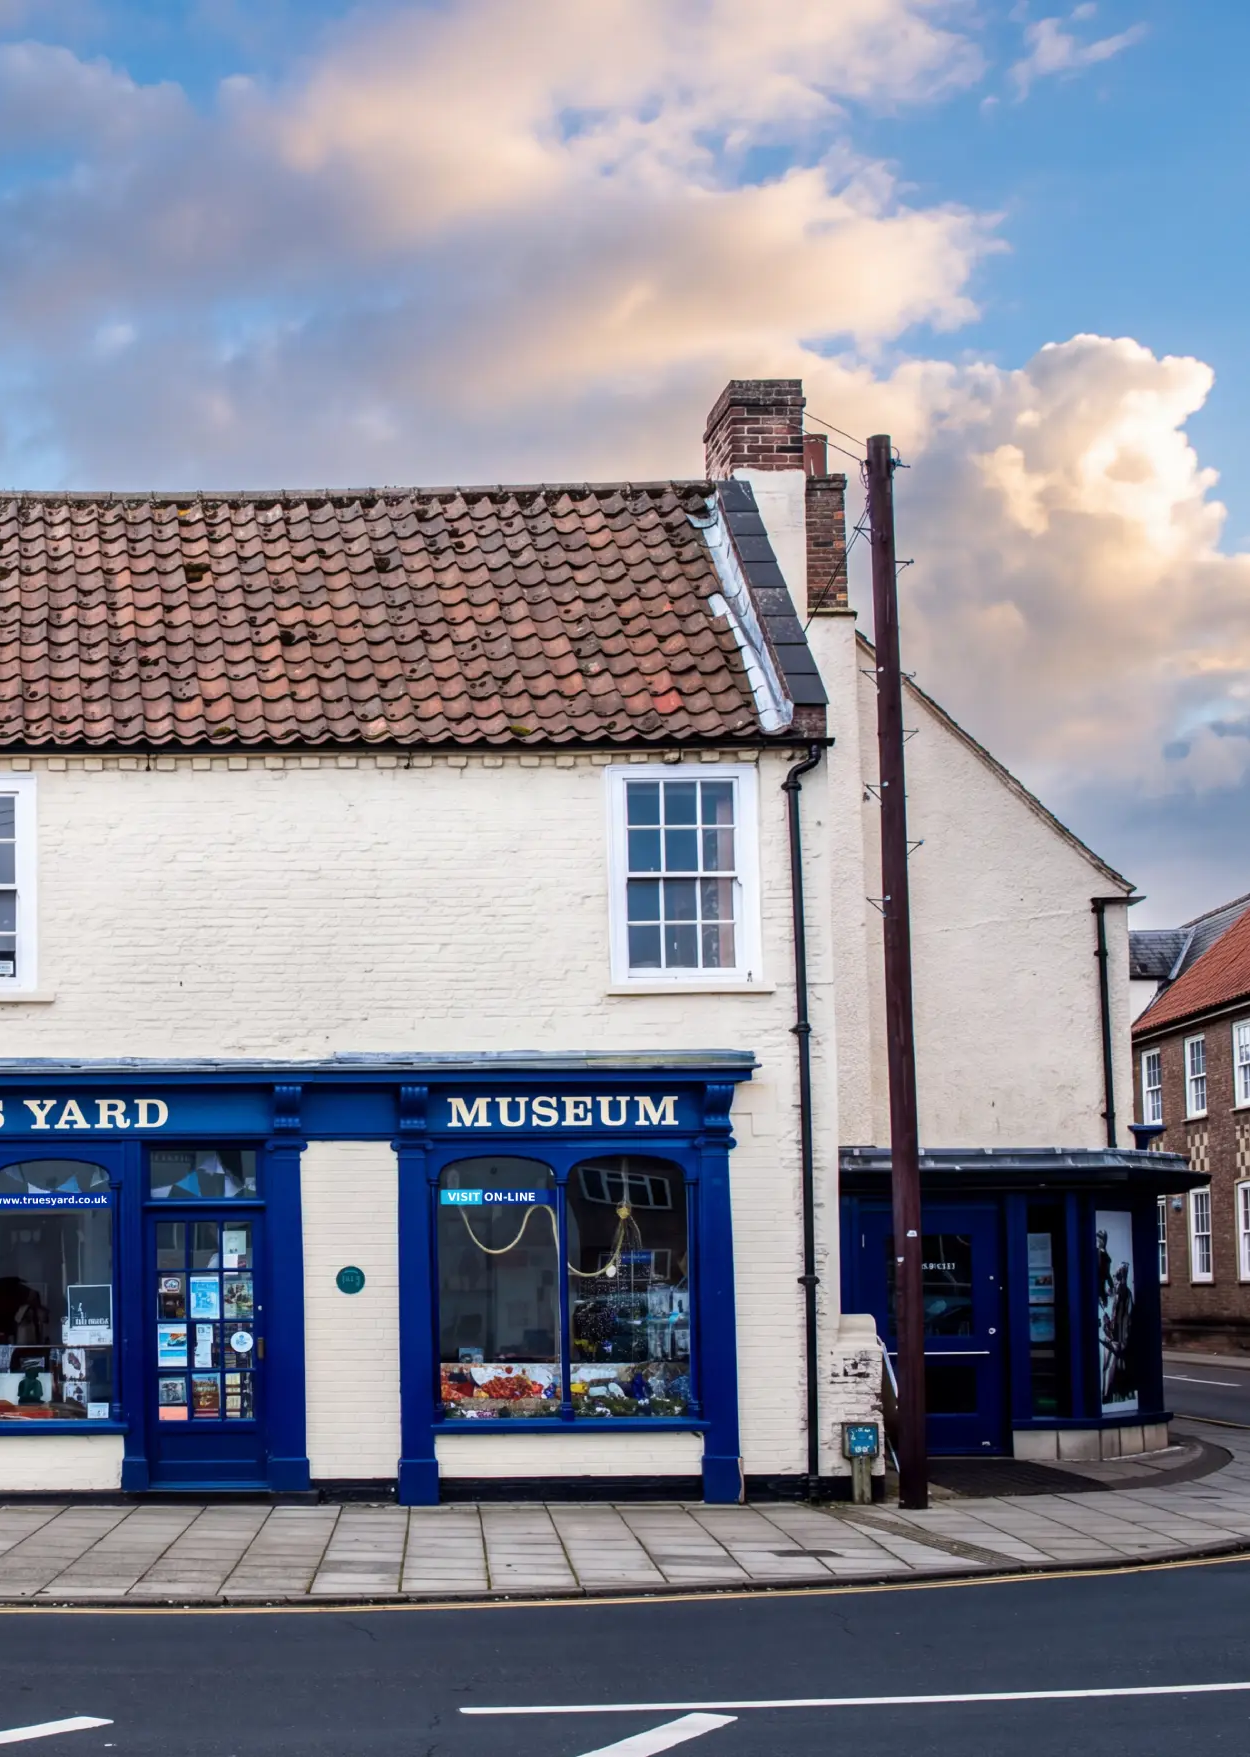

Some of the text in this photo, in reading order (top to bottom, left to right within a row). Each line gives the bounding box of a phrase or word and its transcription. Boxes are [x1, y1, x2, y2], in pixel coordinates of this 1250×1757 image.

[23, 1098, 170, 1130] YARD
[446, 1095, 680, 1127] MUSEUM
[447, 1192, 536, 1202] VISIT ON-LINE
